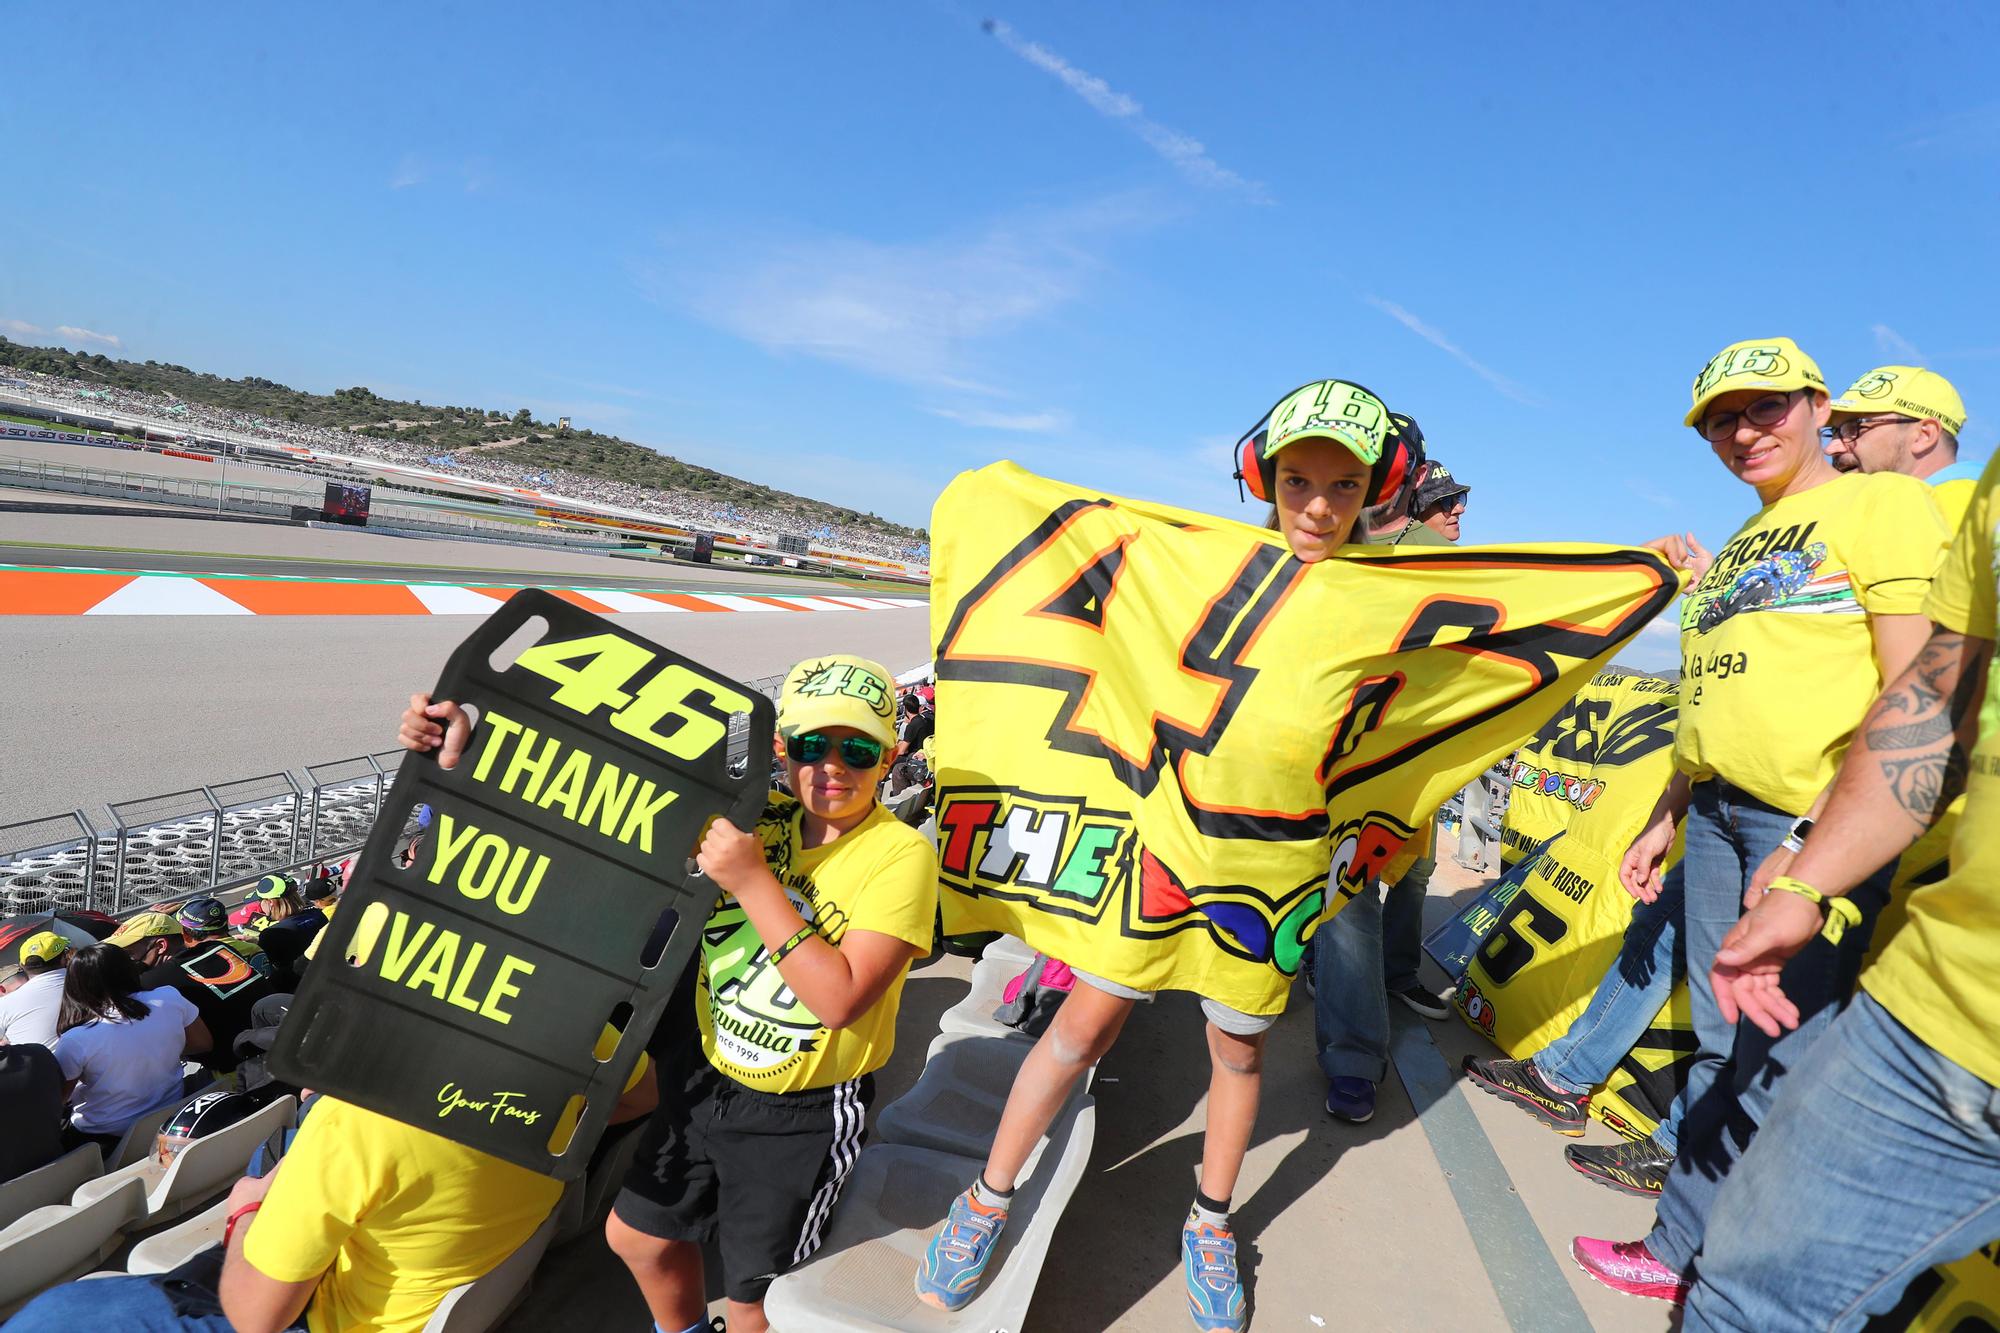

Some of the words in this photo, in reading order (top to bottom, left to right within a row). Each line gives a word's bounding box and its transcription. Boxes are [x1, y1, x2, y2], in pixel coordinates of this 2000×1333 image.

[1700, 346, 1781, 393] 46
[1270, 380, 1382, 434] 46
[1432, 466, 1450, 480] 46
[514, 632, 755, 761] 46
[800, 664, 887, 705] 46
[471, 711, 679, 855] THANK
[426, 814, 552, 915] YOU
[938, 800, 1122, 902] THE
[1552, 867, 1594, 904] ROSSI
[1463, 905, 1498, 937] VALE
[377, 911, 537, 1025] VALE
[736, 1044, 760, 1062] 1996
[437, 1082, 490, 1117] Your
[489, 1091, 542, 1125] Fans
[1502, 1079, 1516, 1092] LA
[1517, 1085, 1567, 1113] SPORTIVA
[1645, 1179, 1663, 1190] LA
[970, 1216, 994, 1229] GEOX
[1613, 1266, 1636, 1280] LA
[1641, 1272, 1692, 1288] SPOR
